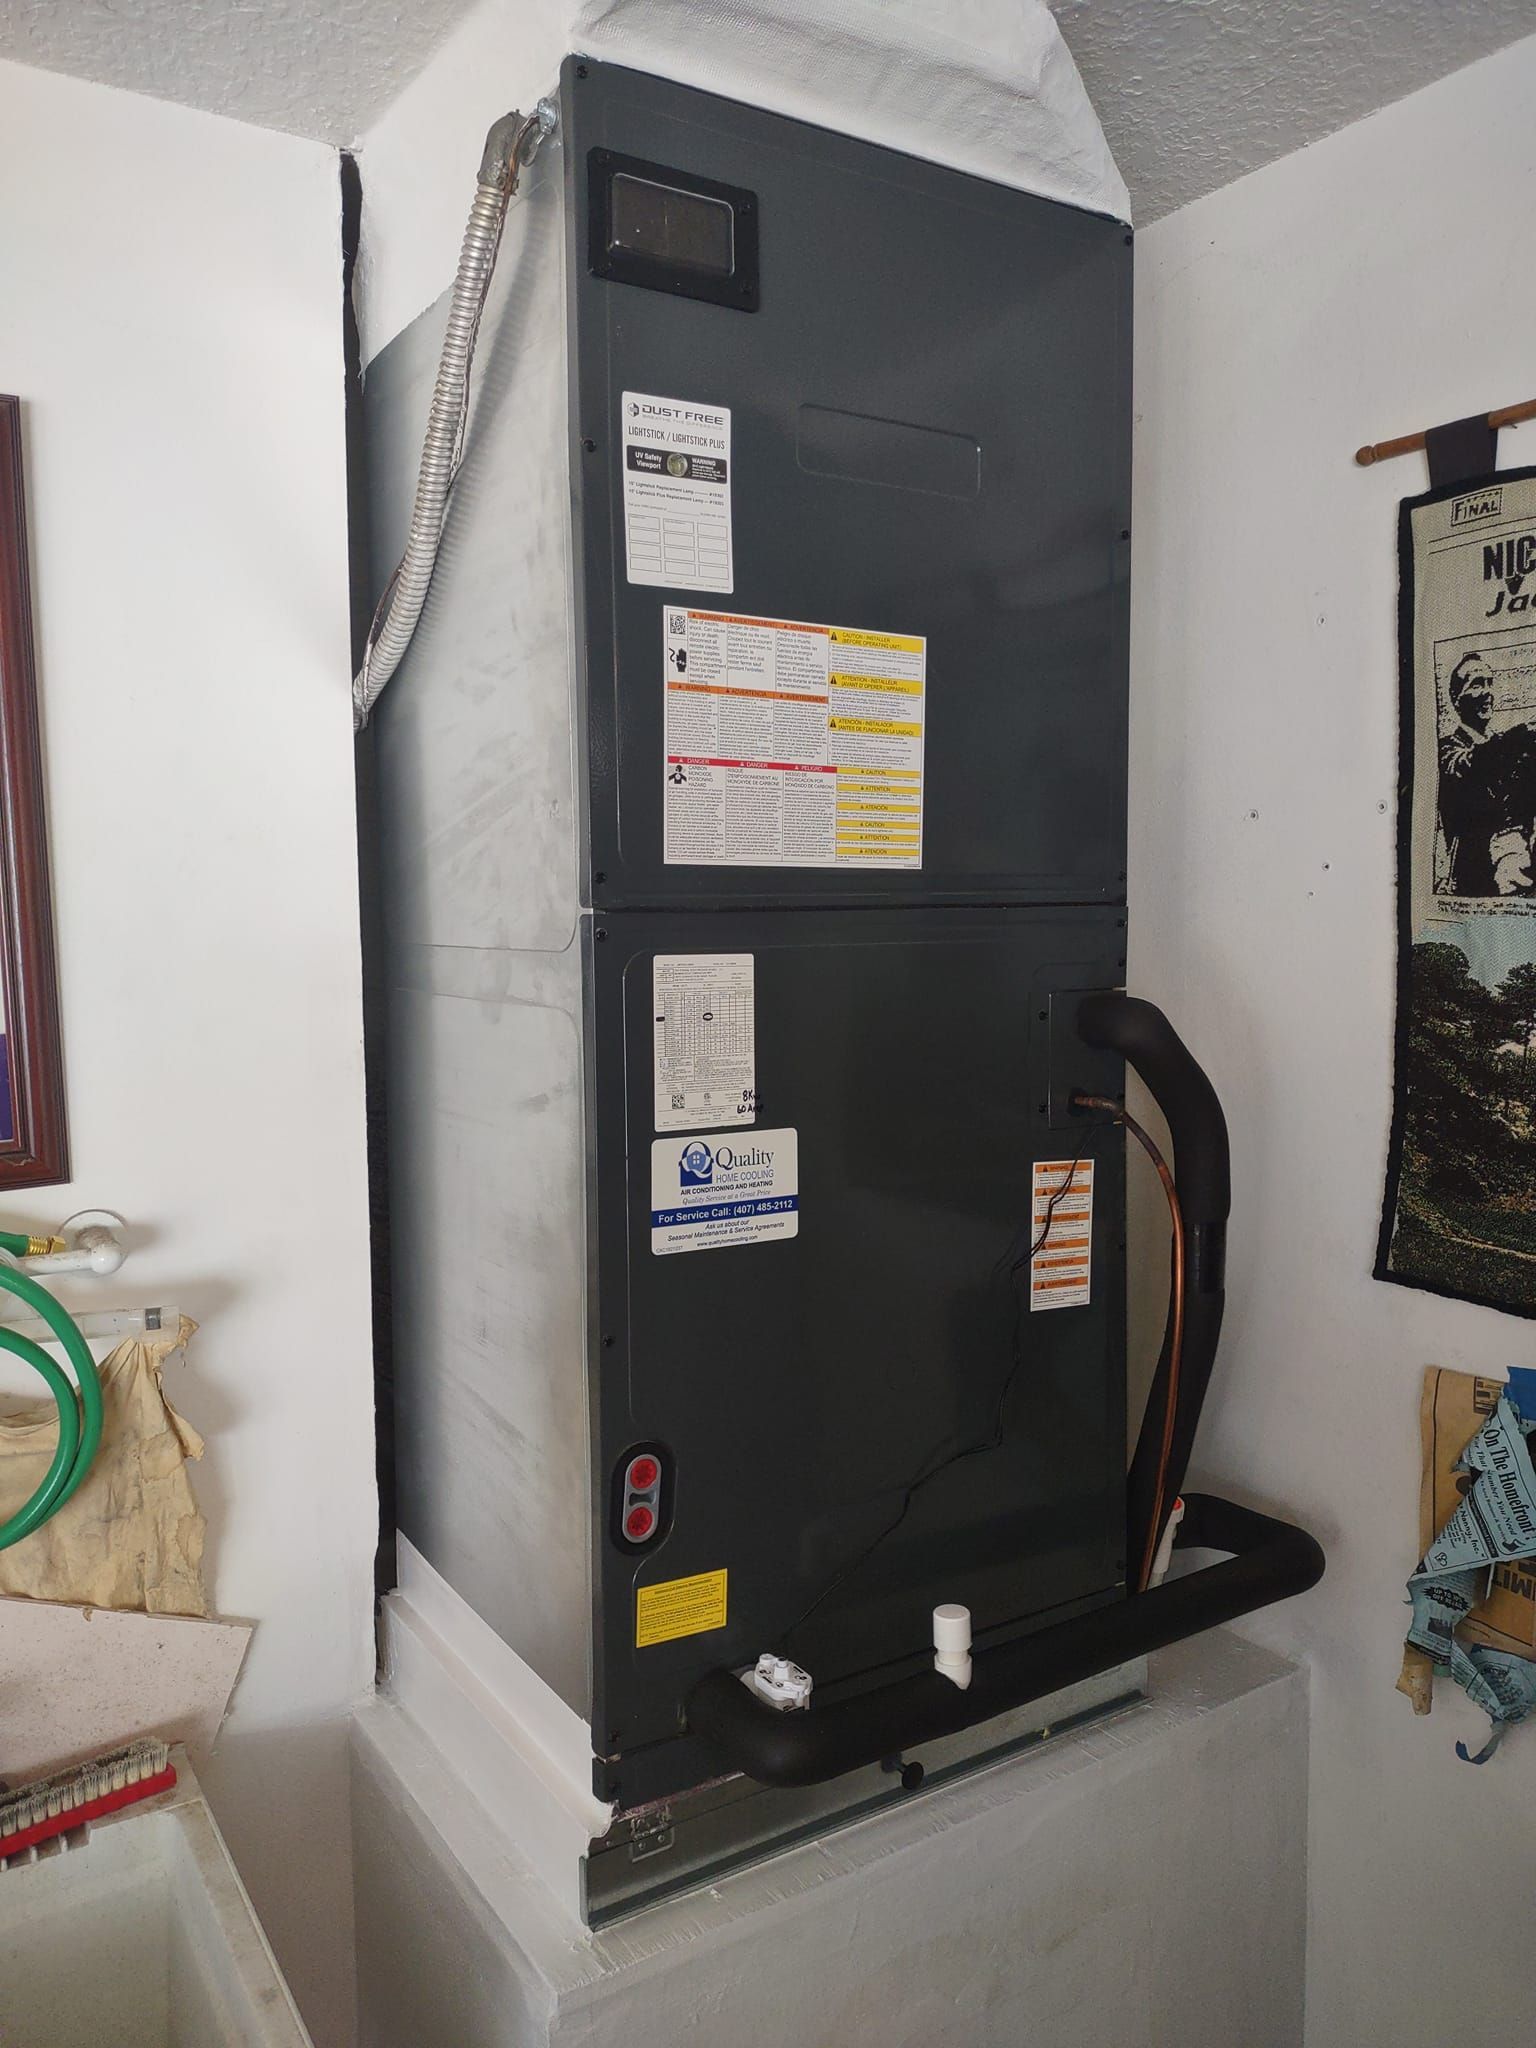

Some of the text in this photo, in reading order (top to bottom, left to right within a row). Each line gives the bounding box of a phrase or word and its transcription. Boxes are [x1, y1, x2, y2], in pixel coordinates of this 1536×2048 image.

[642, 404, 724, 426] DUST FREE
[628, 425, 665, 441] LIGHTSTICK
[672, 432, 708, 448] LIGHTSTICK
[709, 438, 726, 450] PLUS
[636, 460, 661, 470] Viewport
[644, 452, 662, 463] Safety
[692, 458, 716, 466] WARNING
[1454, 499, 1498, 522] FINAL
[862, 640, 888, 648] OPERATING
[716, 1146, 774, 1170] Quality
[716, 1169, 774, 1183] HOME COOLING
[692, 1184, 734, 1194] CONDITIONING
[749, 1180, 773, 1188] HEATING
[658, 1200, 793, 1223] For Service Call: (407) 485-2112
[668, 1233, 693, 1241] Seasonal
[694, 1230, 728, 1239] Maintenance
[754, 1222, 784, 1231] Agreements
[1484, 1429, 1500, 1447] On
[1491, 1446, 1510, 1471] The
[1471, 1539, 1480, 1555] Inc.
